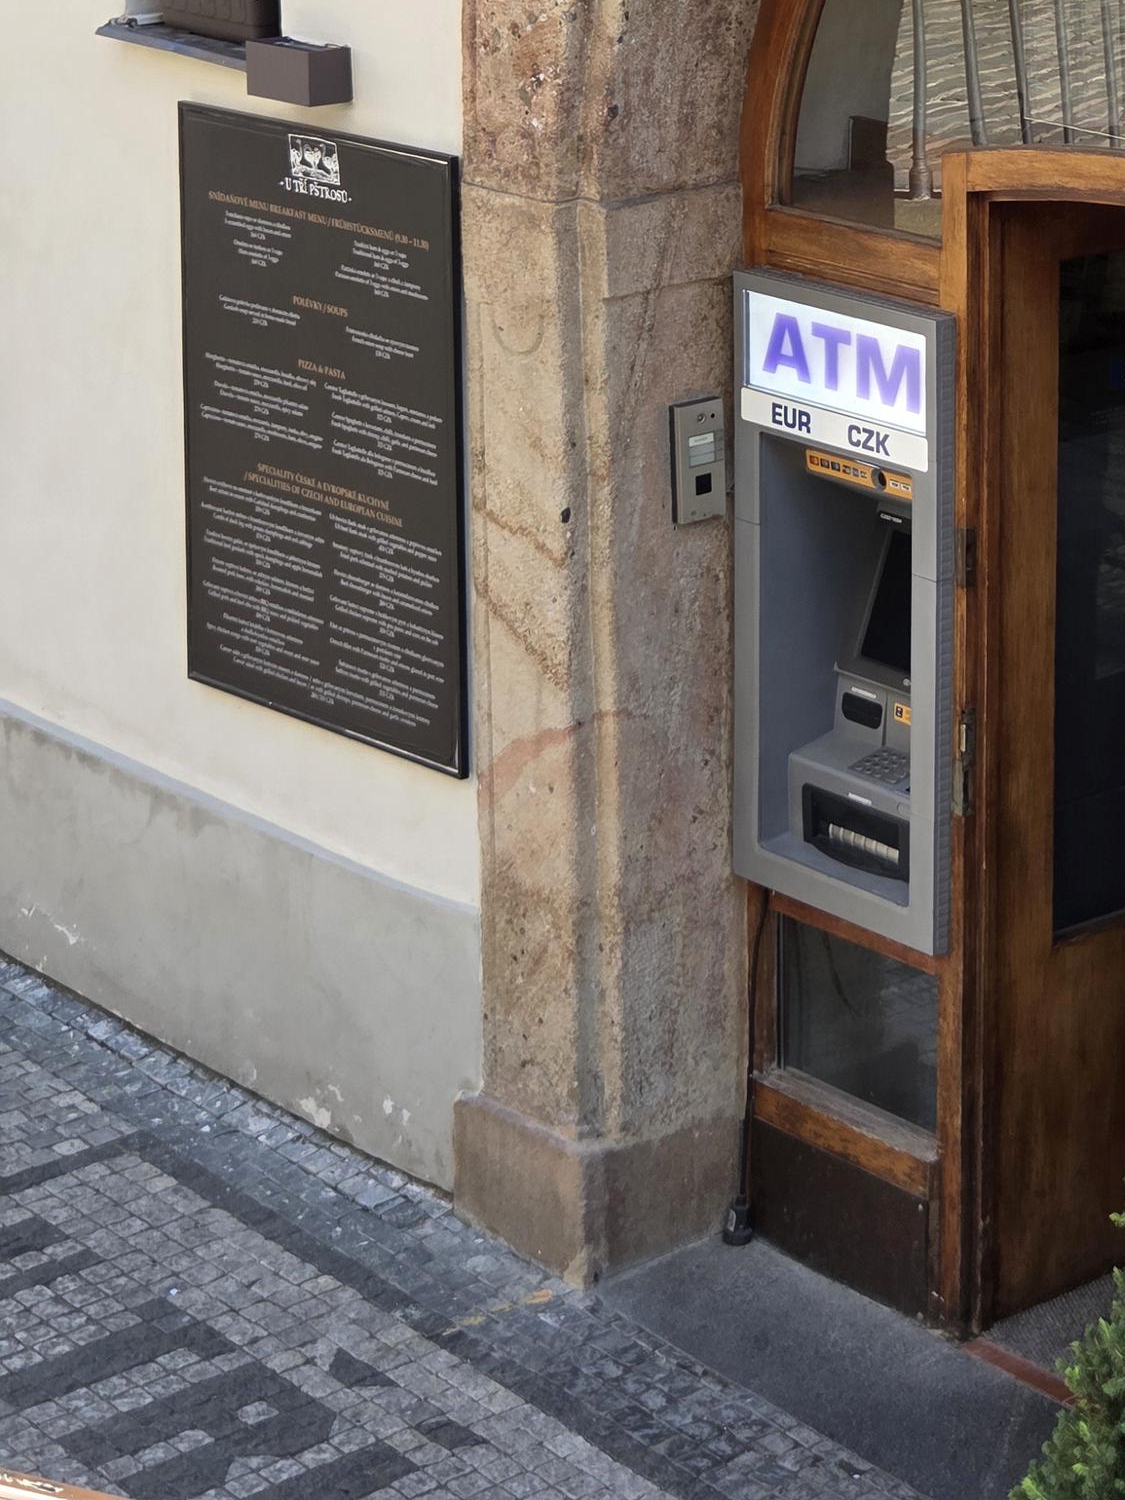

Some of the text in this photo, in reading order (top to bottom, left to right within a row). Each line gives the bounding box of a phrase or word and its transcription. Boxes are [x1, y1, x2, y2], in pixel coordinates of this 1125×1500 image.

[285, 177, 347, 203] U TŘÍ PŠTROSŮ
[762, 312, 922, 415] ATM
[771, 402, 890, 457] EUR CZK
